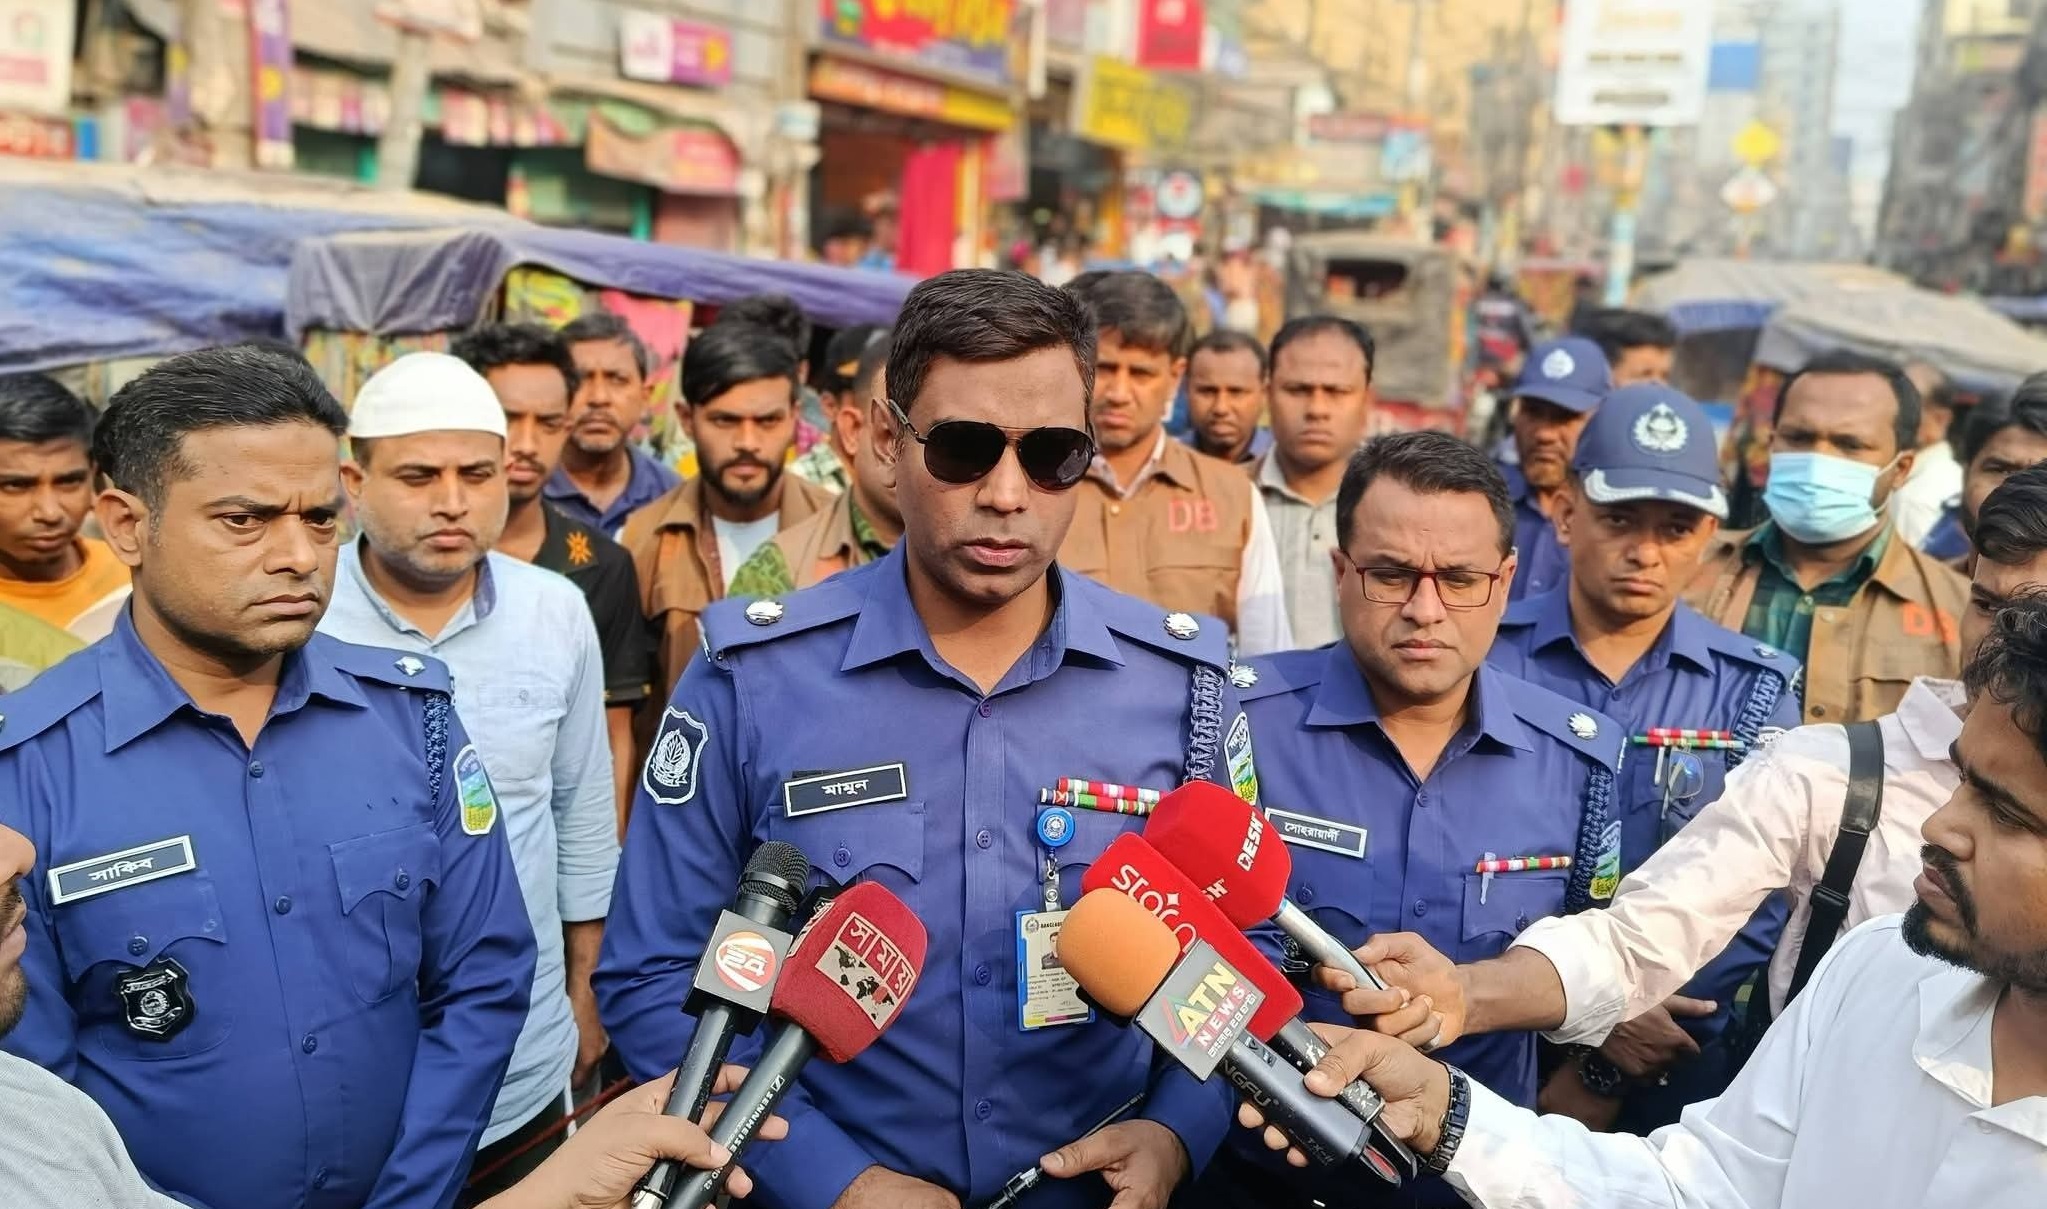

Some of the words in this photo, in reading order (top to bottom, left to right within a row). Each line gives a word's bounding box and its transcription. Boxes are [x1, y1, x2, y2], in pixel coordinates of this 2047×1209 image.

[1168, 499, 1217, 532] DB
[821, 779, 869, 795] মামুন
[87, 857, 154, 881] সাকিব
[1237, 813, 1264, 871] DESH
[850, 917, 914, 995] সময়
[1178, 961, 1238, 1039] ATN
[1197, 985, 1246, 1047] NEWS
[728, 1091, 774, 1152] SENNHEISE
